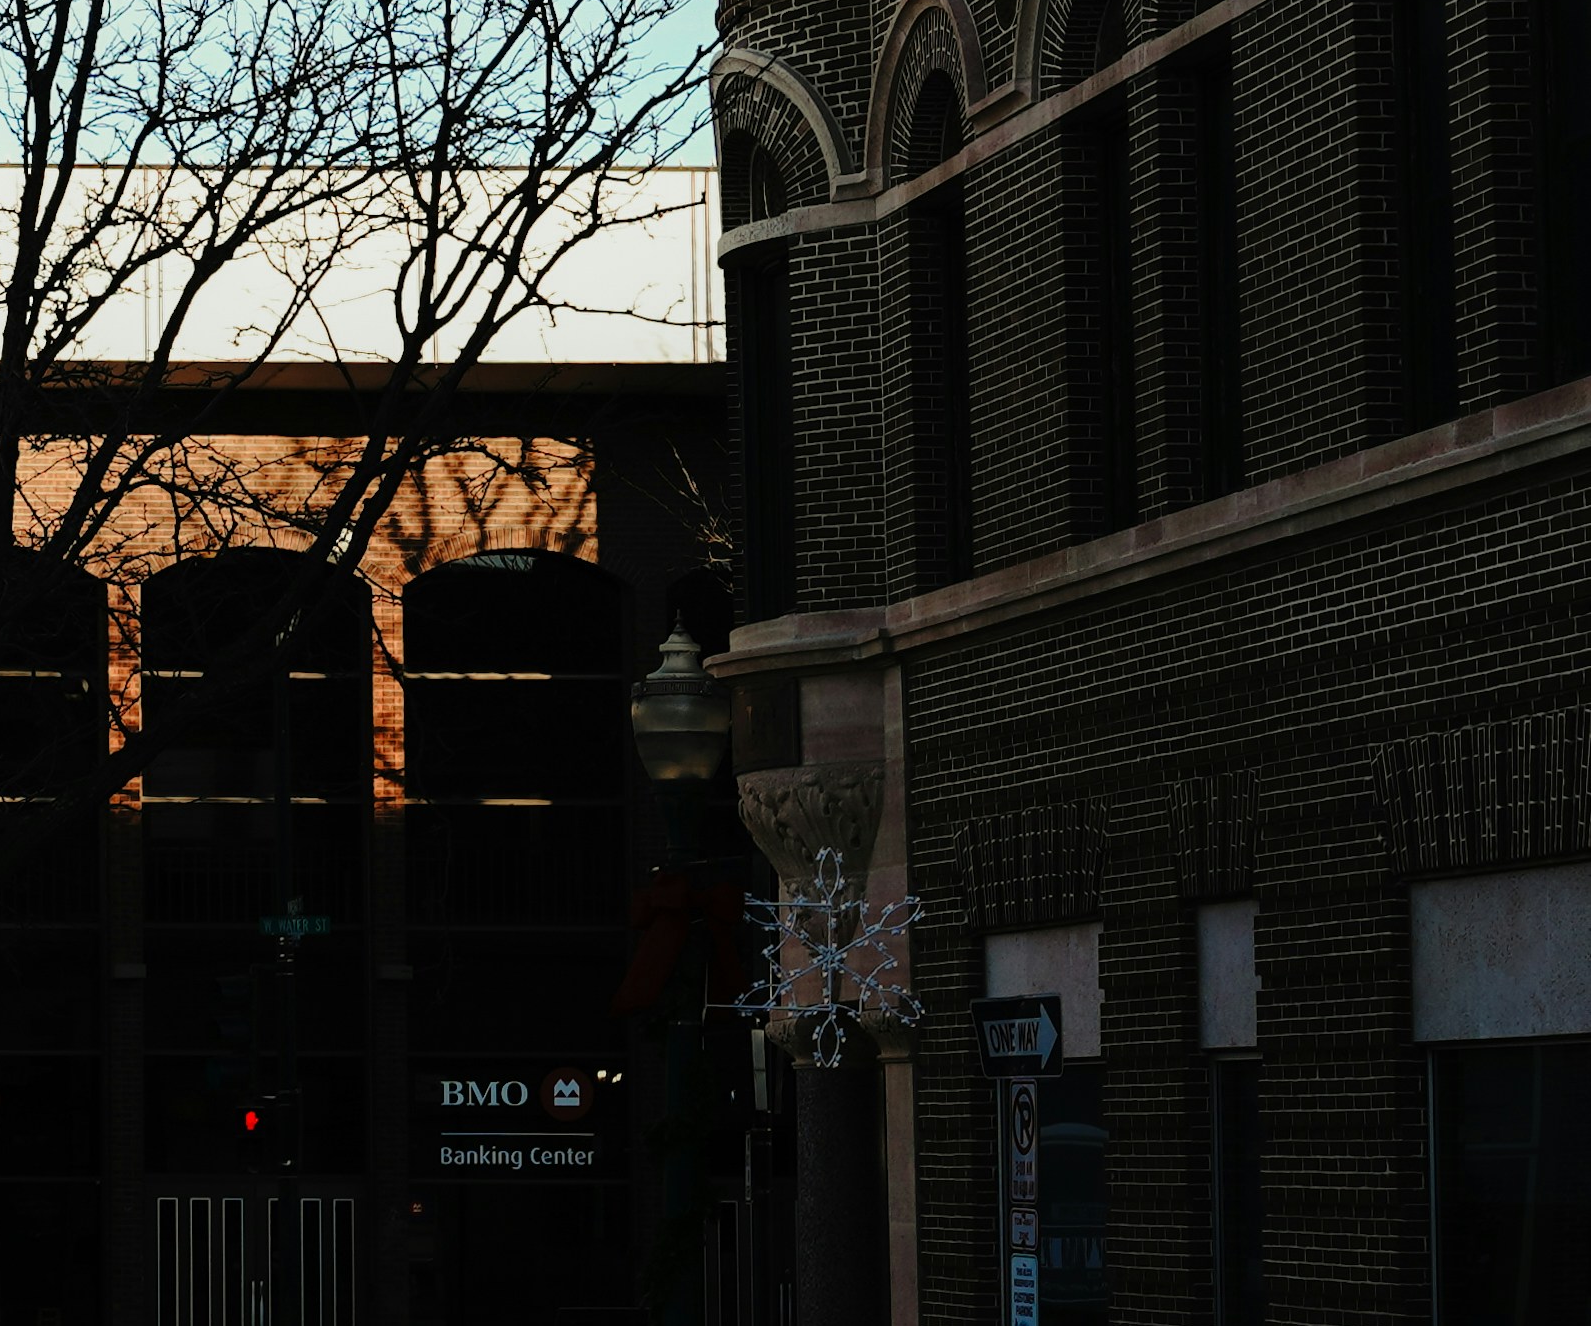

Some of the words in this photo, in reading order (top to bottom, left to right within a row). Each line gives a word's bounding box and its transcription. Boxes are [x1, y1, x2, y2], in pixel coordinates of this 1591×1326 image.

[278, 918, 309, 933] WATER
[315, 918, 328, 932] ST
[990, 1023, 1016, 1053] ONE
[1017, 1021, 1040, 1051] WAY
[441, 1080, 529, 1107] BMO
[440, 1144, 523, 1170] Banking
[529, 1147, 596, 1166] Center
